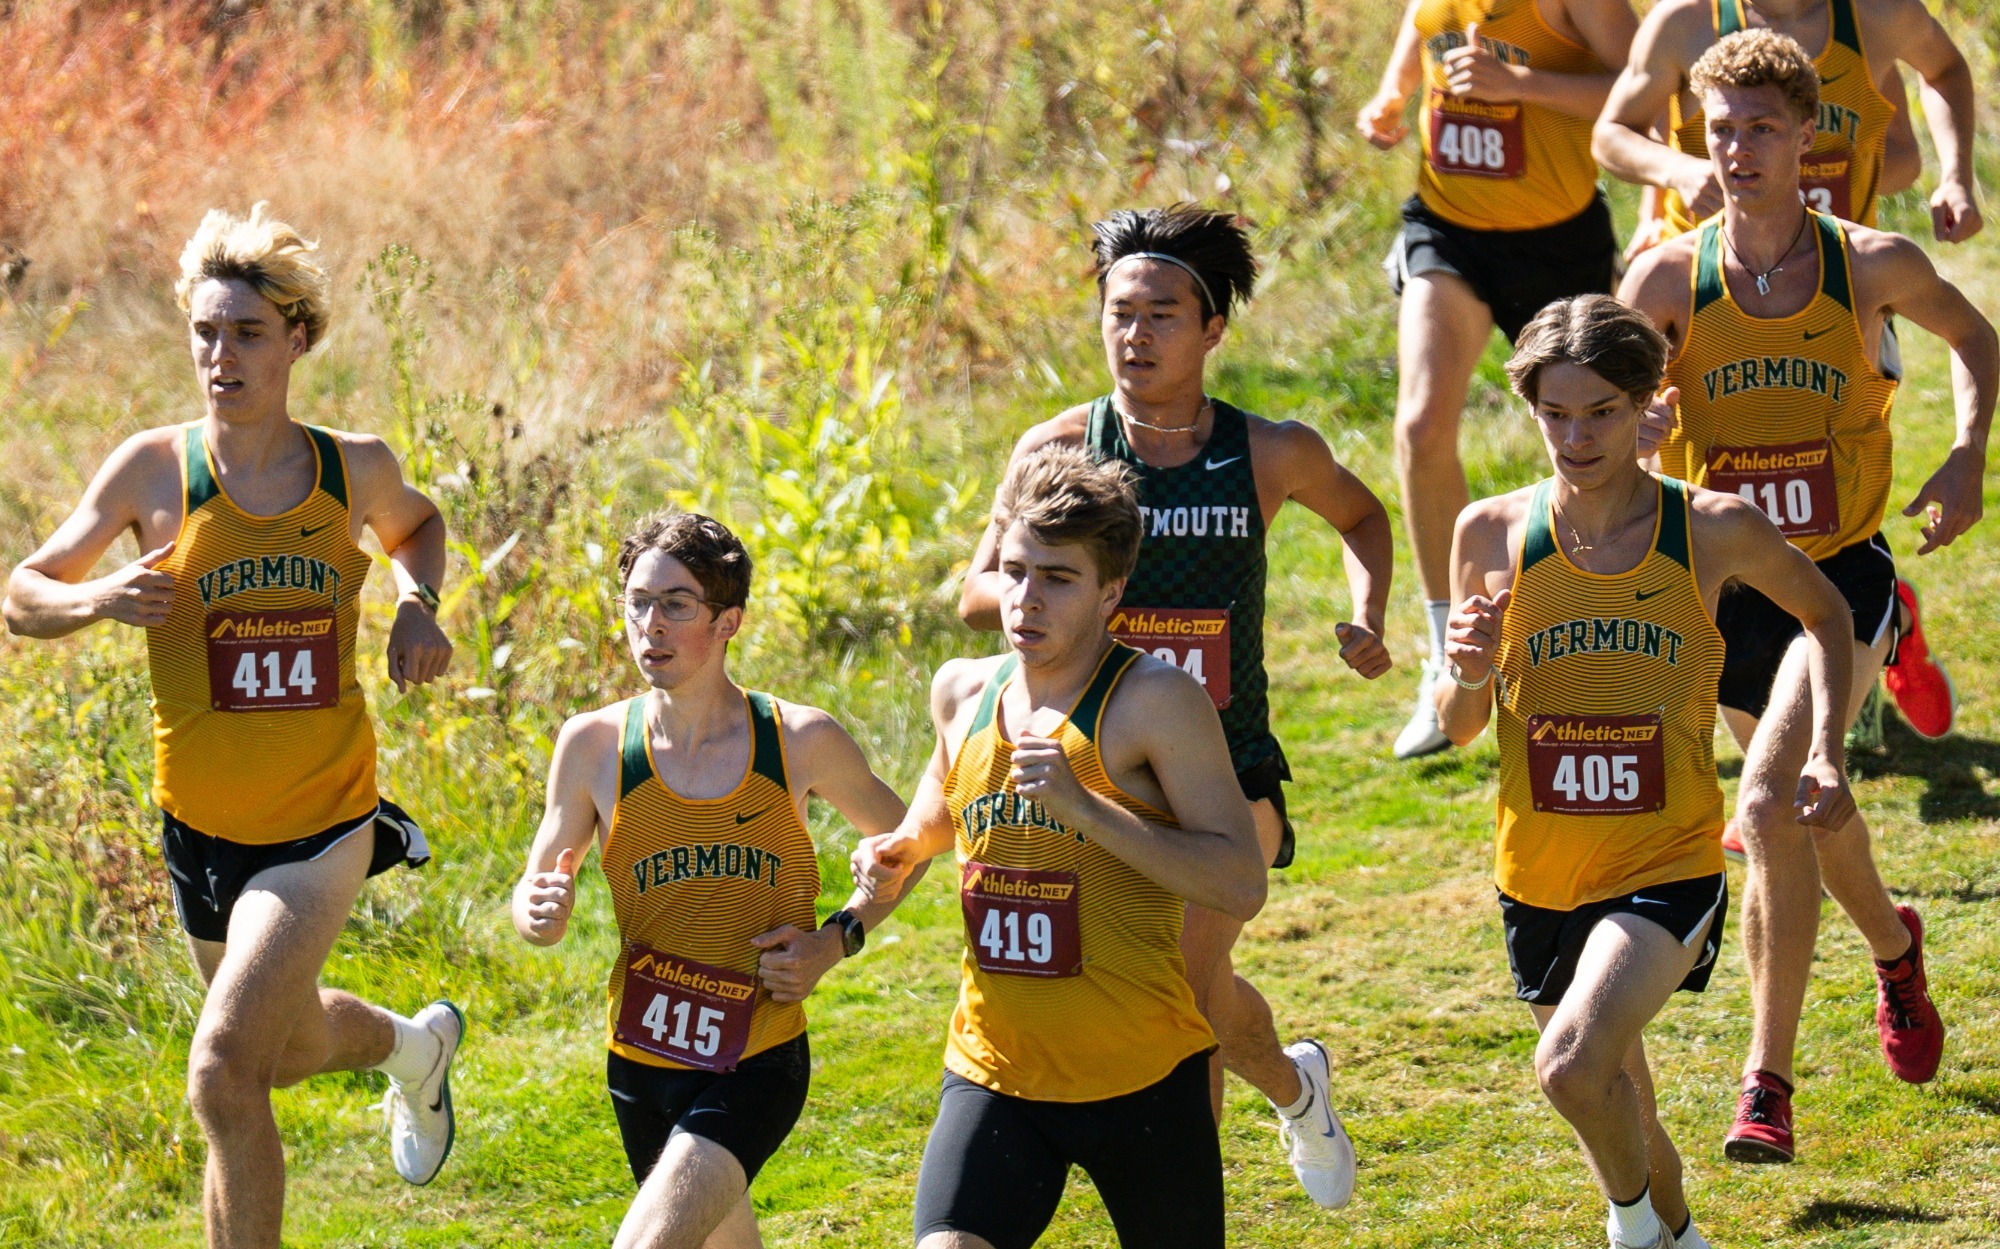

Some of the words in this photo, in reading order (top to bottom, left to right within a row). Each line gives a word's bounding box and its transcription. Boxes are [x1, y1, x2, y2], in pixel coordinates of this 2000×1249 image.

[1439, 123, 1505, 168] 408
[1703, 356, 1848, 403] VERMONT
[1138, 506, 1249, 538] TMOUTH
[197, 554, 341, 607] VERMONT
[1526, 618, 1684, 669] VERMONT
[232, 650, 317, 698] 414
[1553, 755, 1640, 802] 405
[633, 843, 782, 896] VERMONT
[980, 908, 1052, 963] 419
[641, 992, 725, 1057] 415
